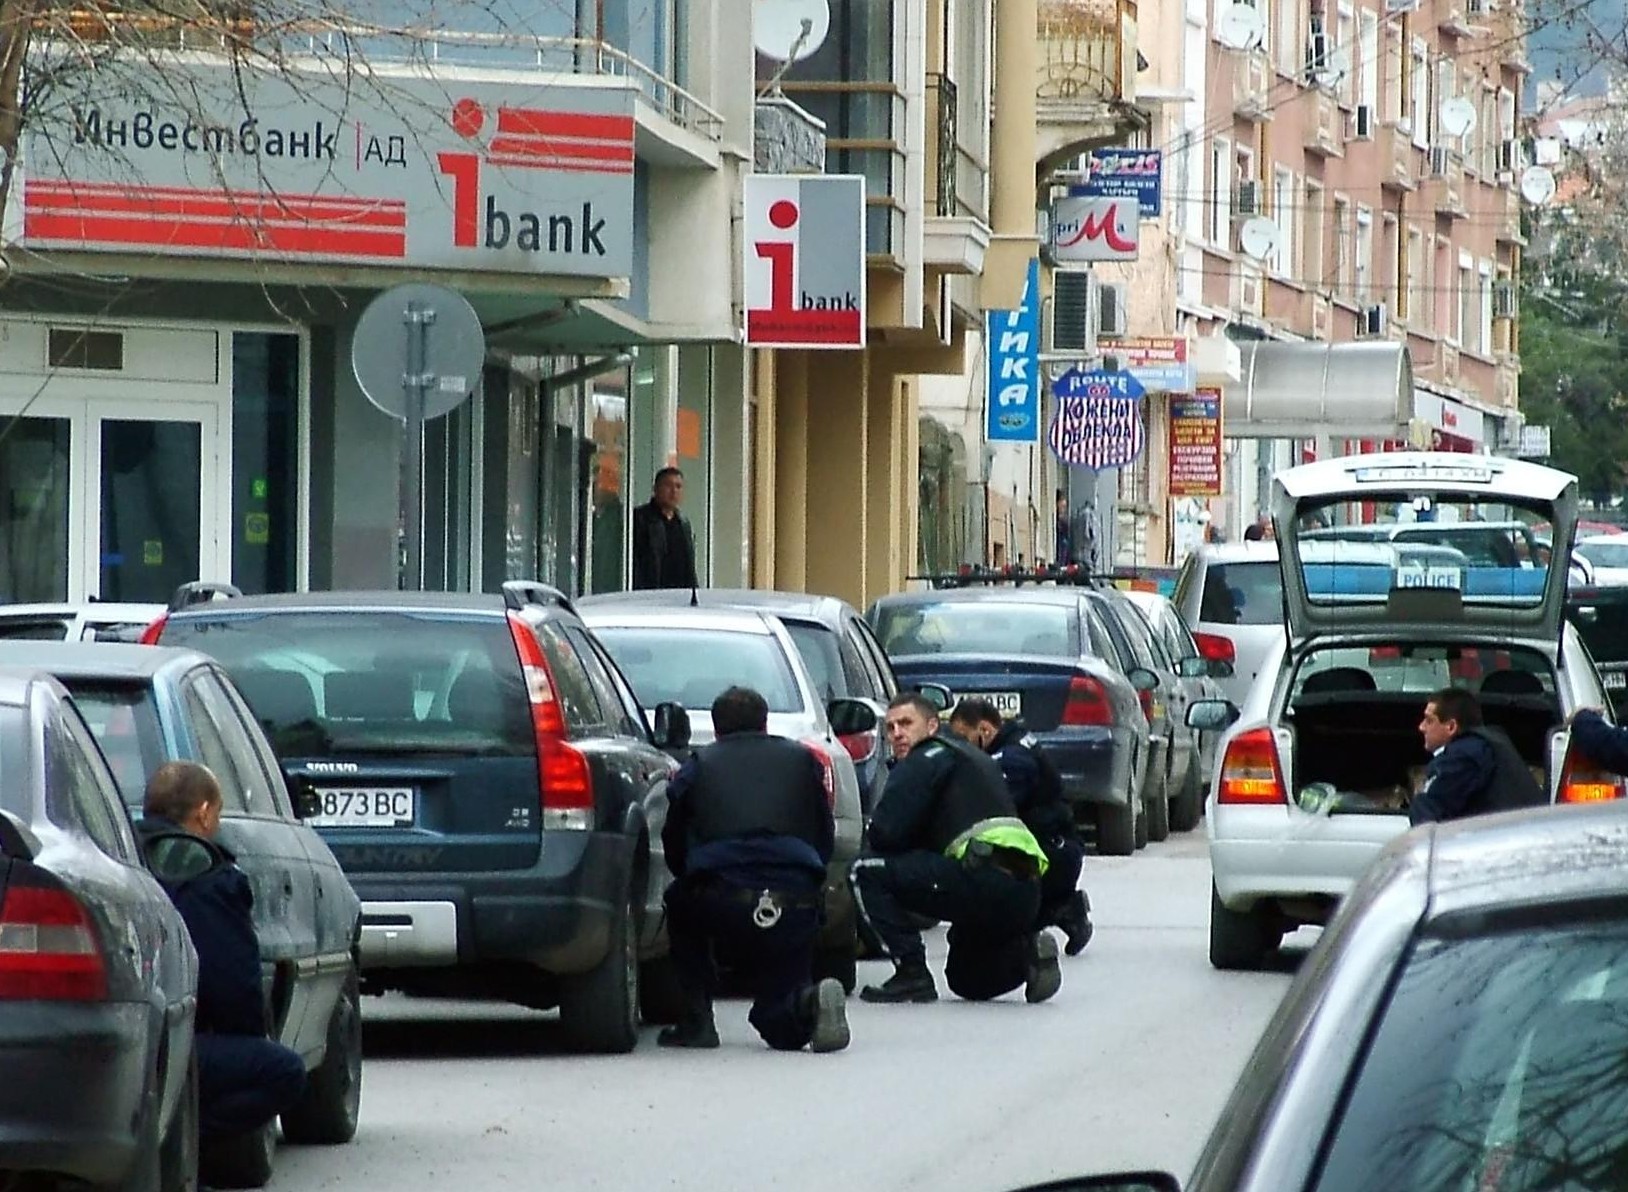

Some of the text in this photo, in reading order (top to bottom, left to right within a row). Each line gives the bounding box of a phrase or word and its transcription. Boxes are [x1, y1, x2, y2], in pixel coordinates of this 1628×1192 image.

[74, 106, 407, 167] Инвестбанк АД
[486, 196, 606, 256] bank
[1070, 376, 1128, 394] ROUTE
[1063, 399, 1130, 421] КОЖЕНИ
[1404, 574, 1456, 587] POLICE
[306, 763, 358, 773] VOLVO
[374, 792, 409, 816] BC
